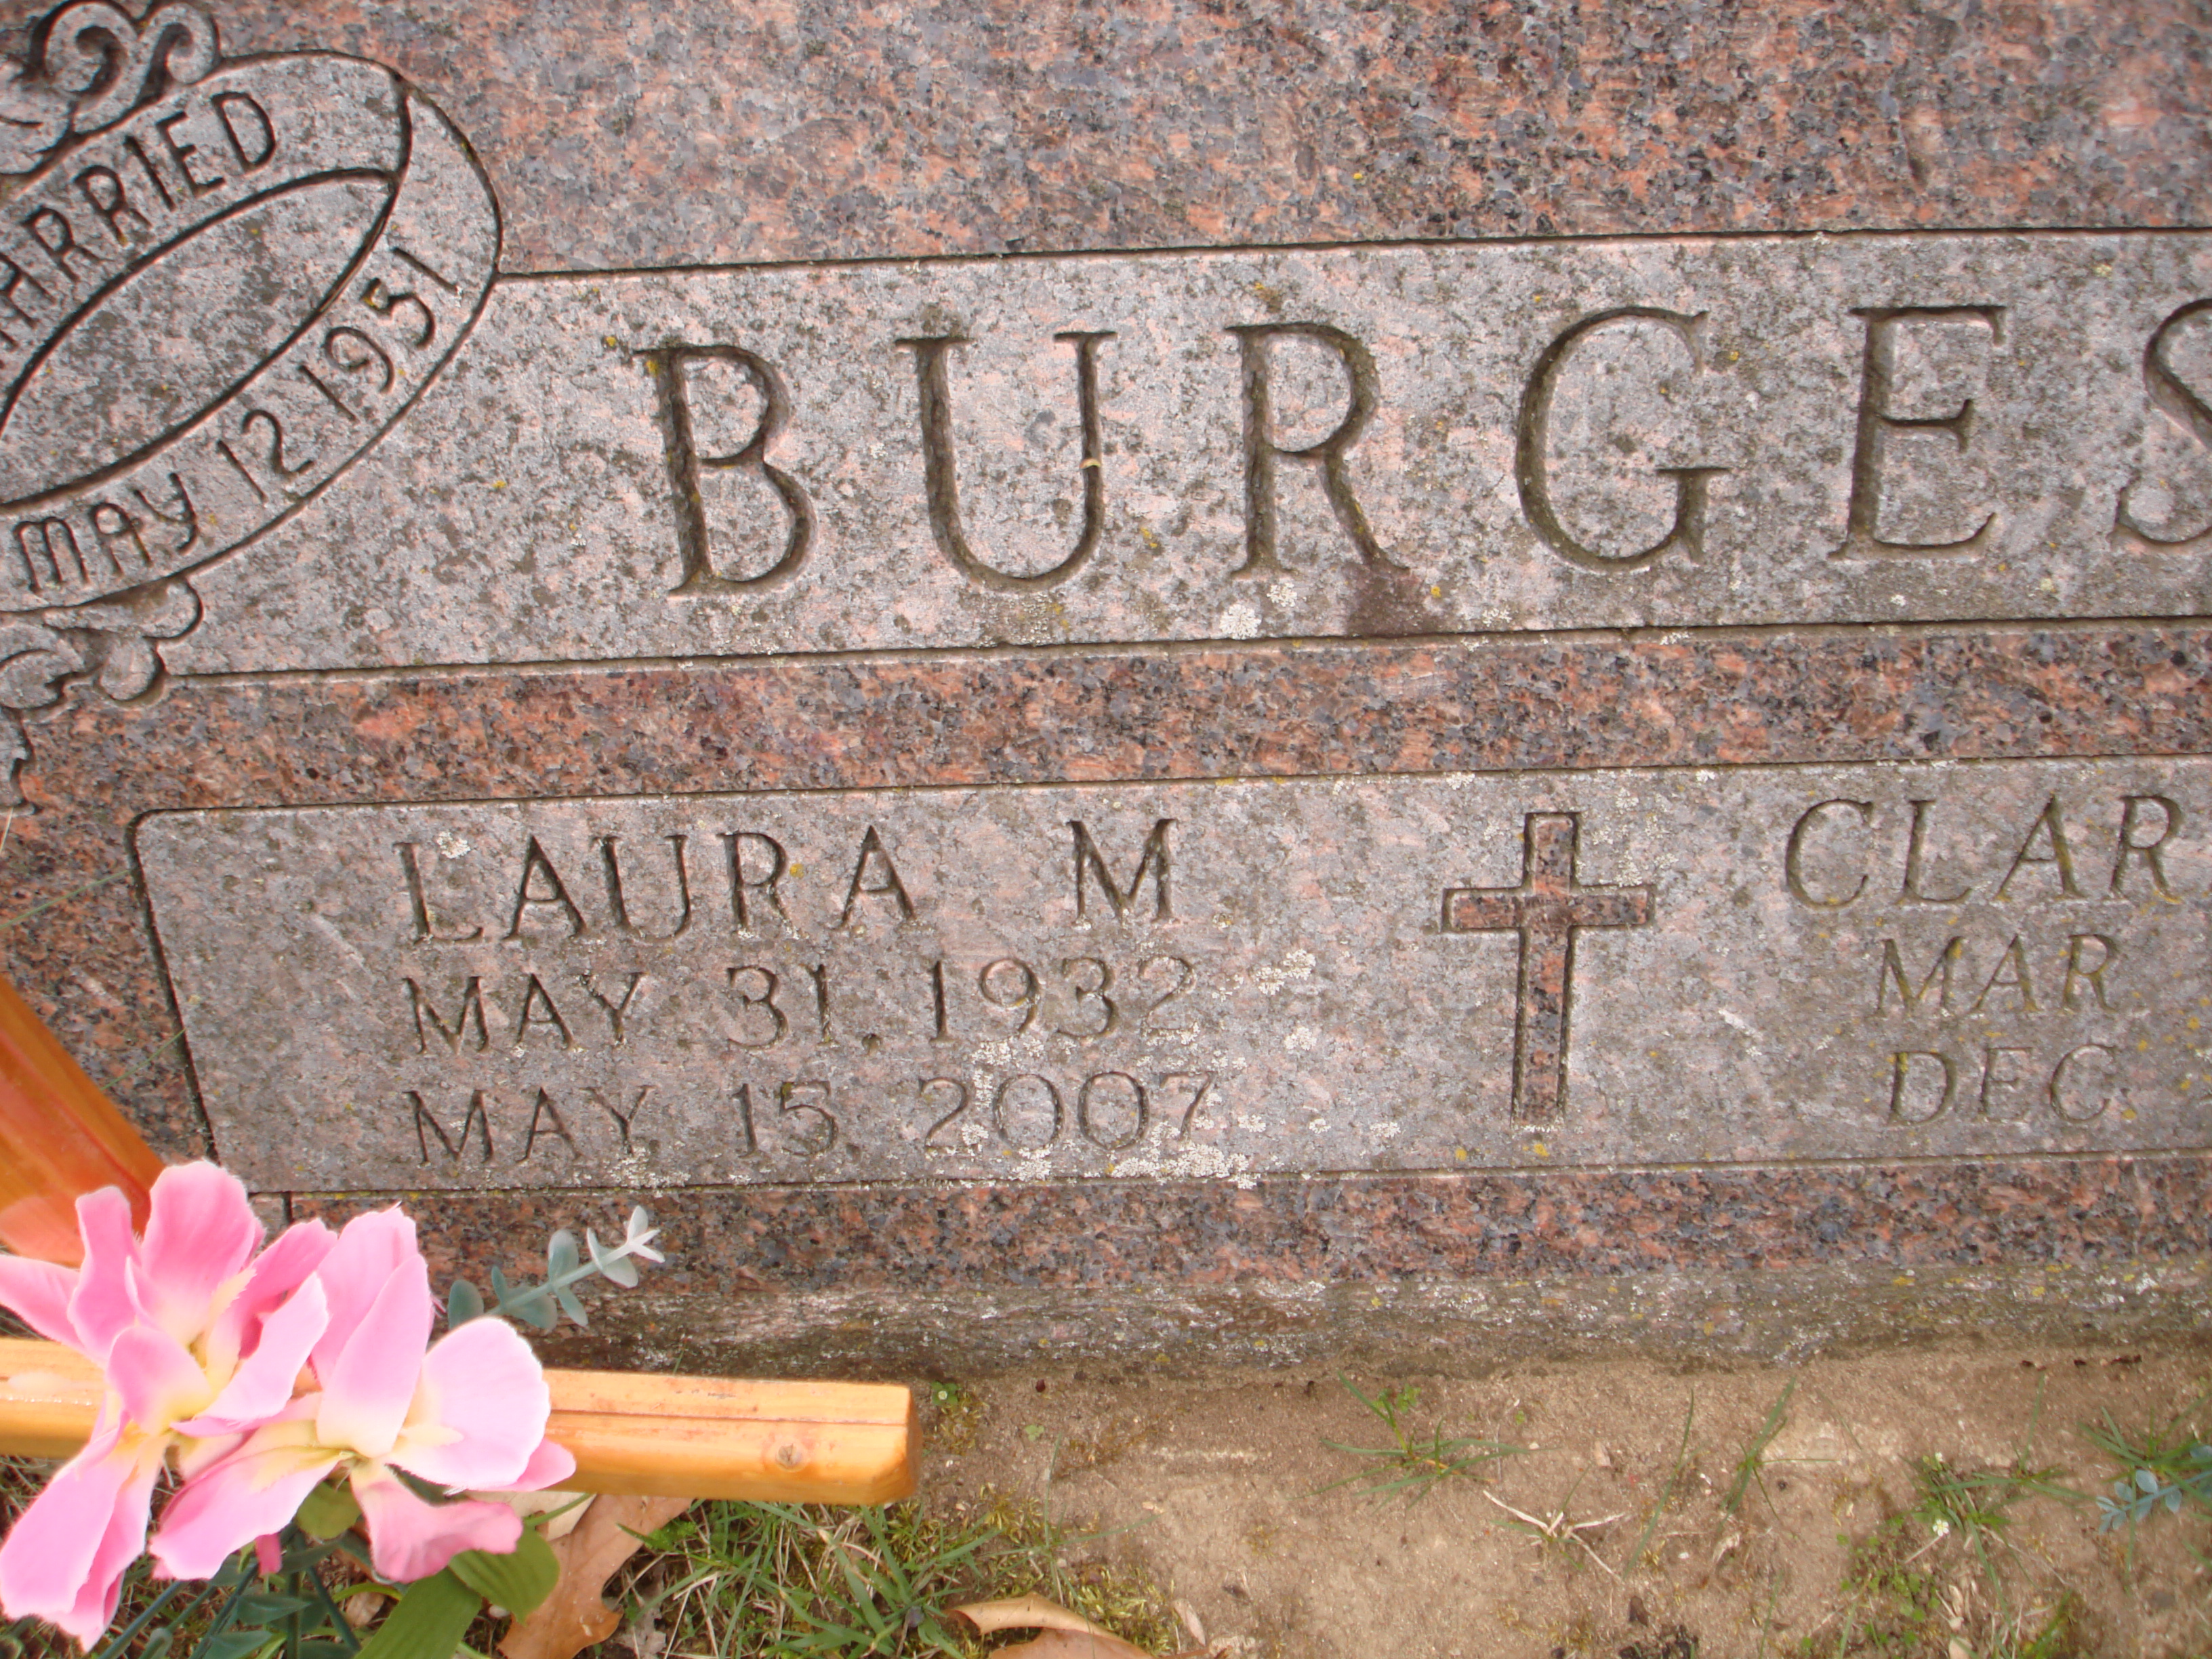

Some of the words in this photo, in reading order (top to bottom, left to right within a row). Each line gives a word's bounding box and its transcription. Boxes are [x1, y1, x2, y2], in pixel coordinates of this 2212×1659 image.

[0, 90, 276, 351] ARRIED
[12, 472, 199, 594] MAY
[216, 409, 314, 507] 12
[298, 247, 464, 423] 1951
[630, 298, 2212, 598] BURGES
[392, 824, 930, 945] LAURA
[1068, 817, 1178, 926] M
[1785, 793, 2182, 908] CLAR
[401, 972, 652, 1054] MAY
[928, 956, 1198, 1044] 1932
[1876, 934, 2120, 1017] MAR
[401, 1086, 657, 1166] MAY
[918, 1069, 1218, 1152] 2007
[1885, 1042, 2120, 1128] DEC
